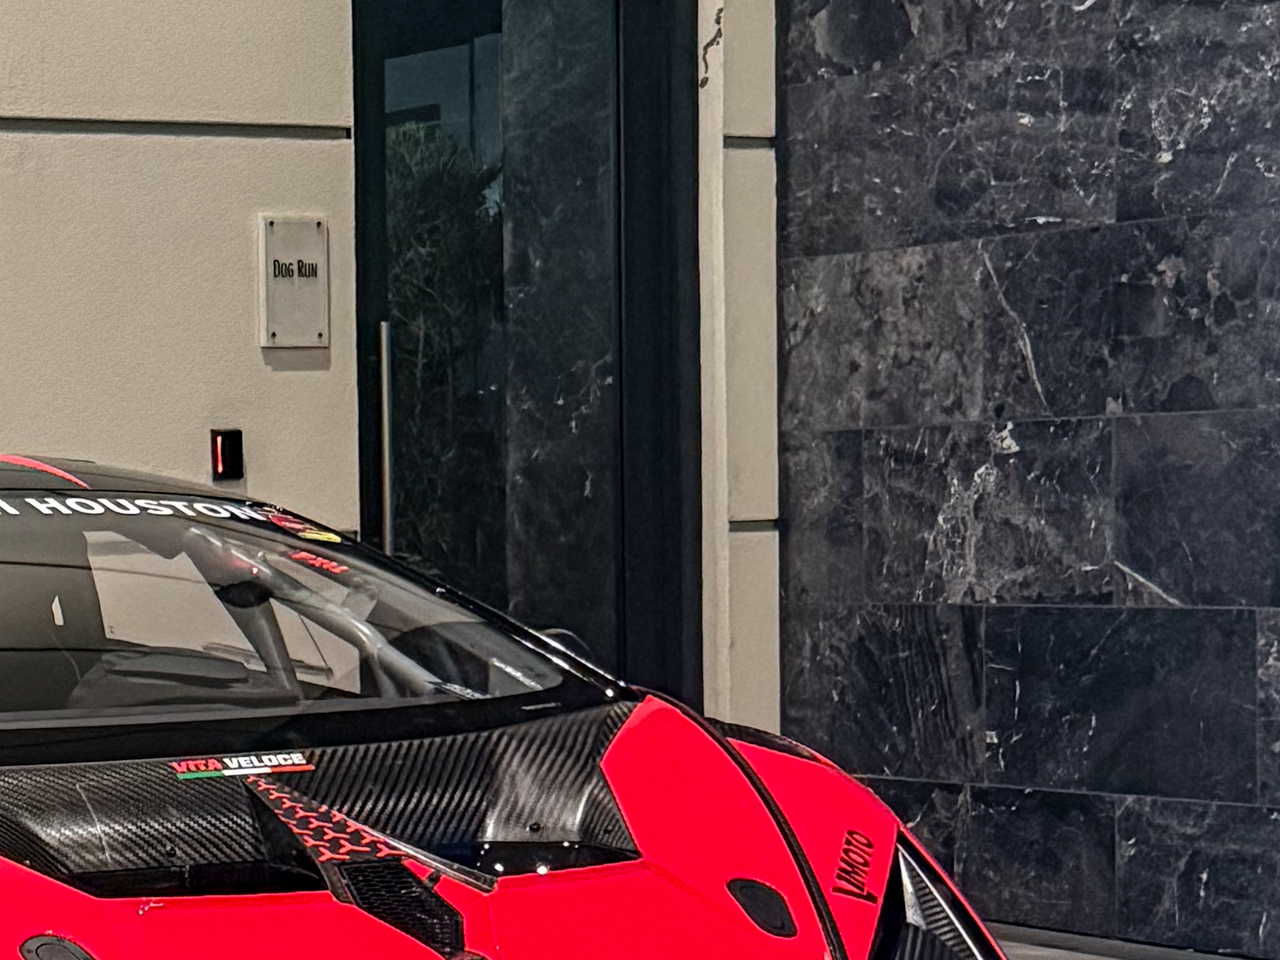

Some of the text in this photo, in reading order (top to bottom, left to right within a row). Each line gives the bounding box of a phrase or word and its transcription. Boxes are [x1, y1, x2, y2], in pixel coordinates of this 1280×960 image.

[23, 497, 268, 522] HOUSTON
[171, 752, 307, 773] VITA VELOCE
